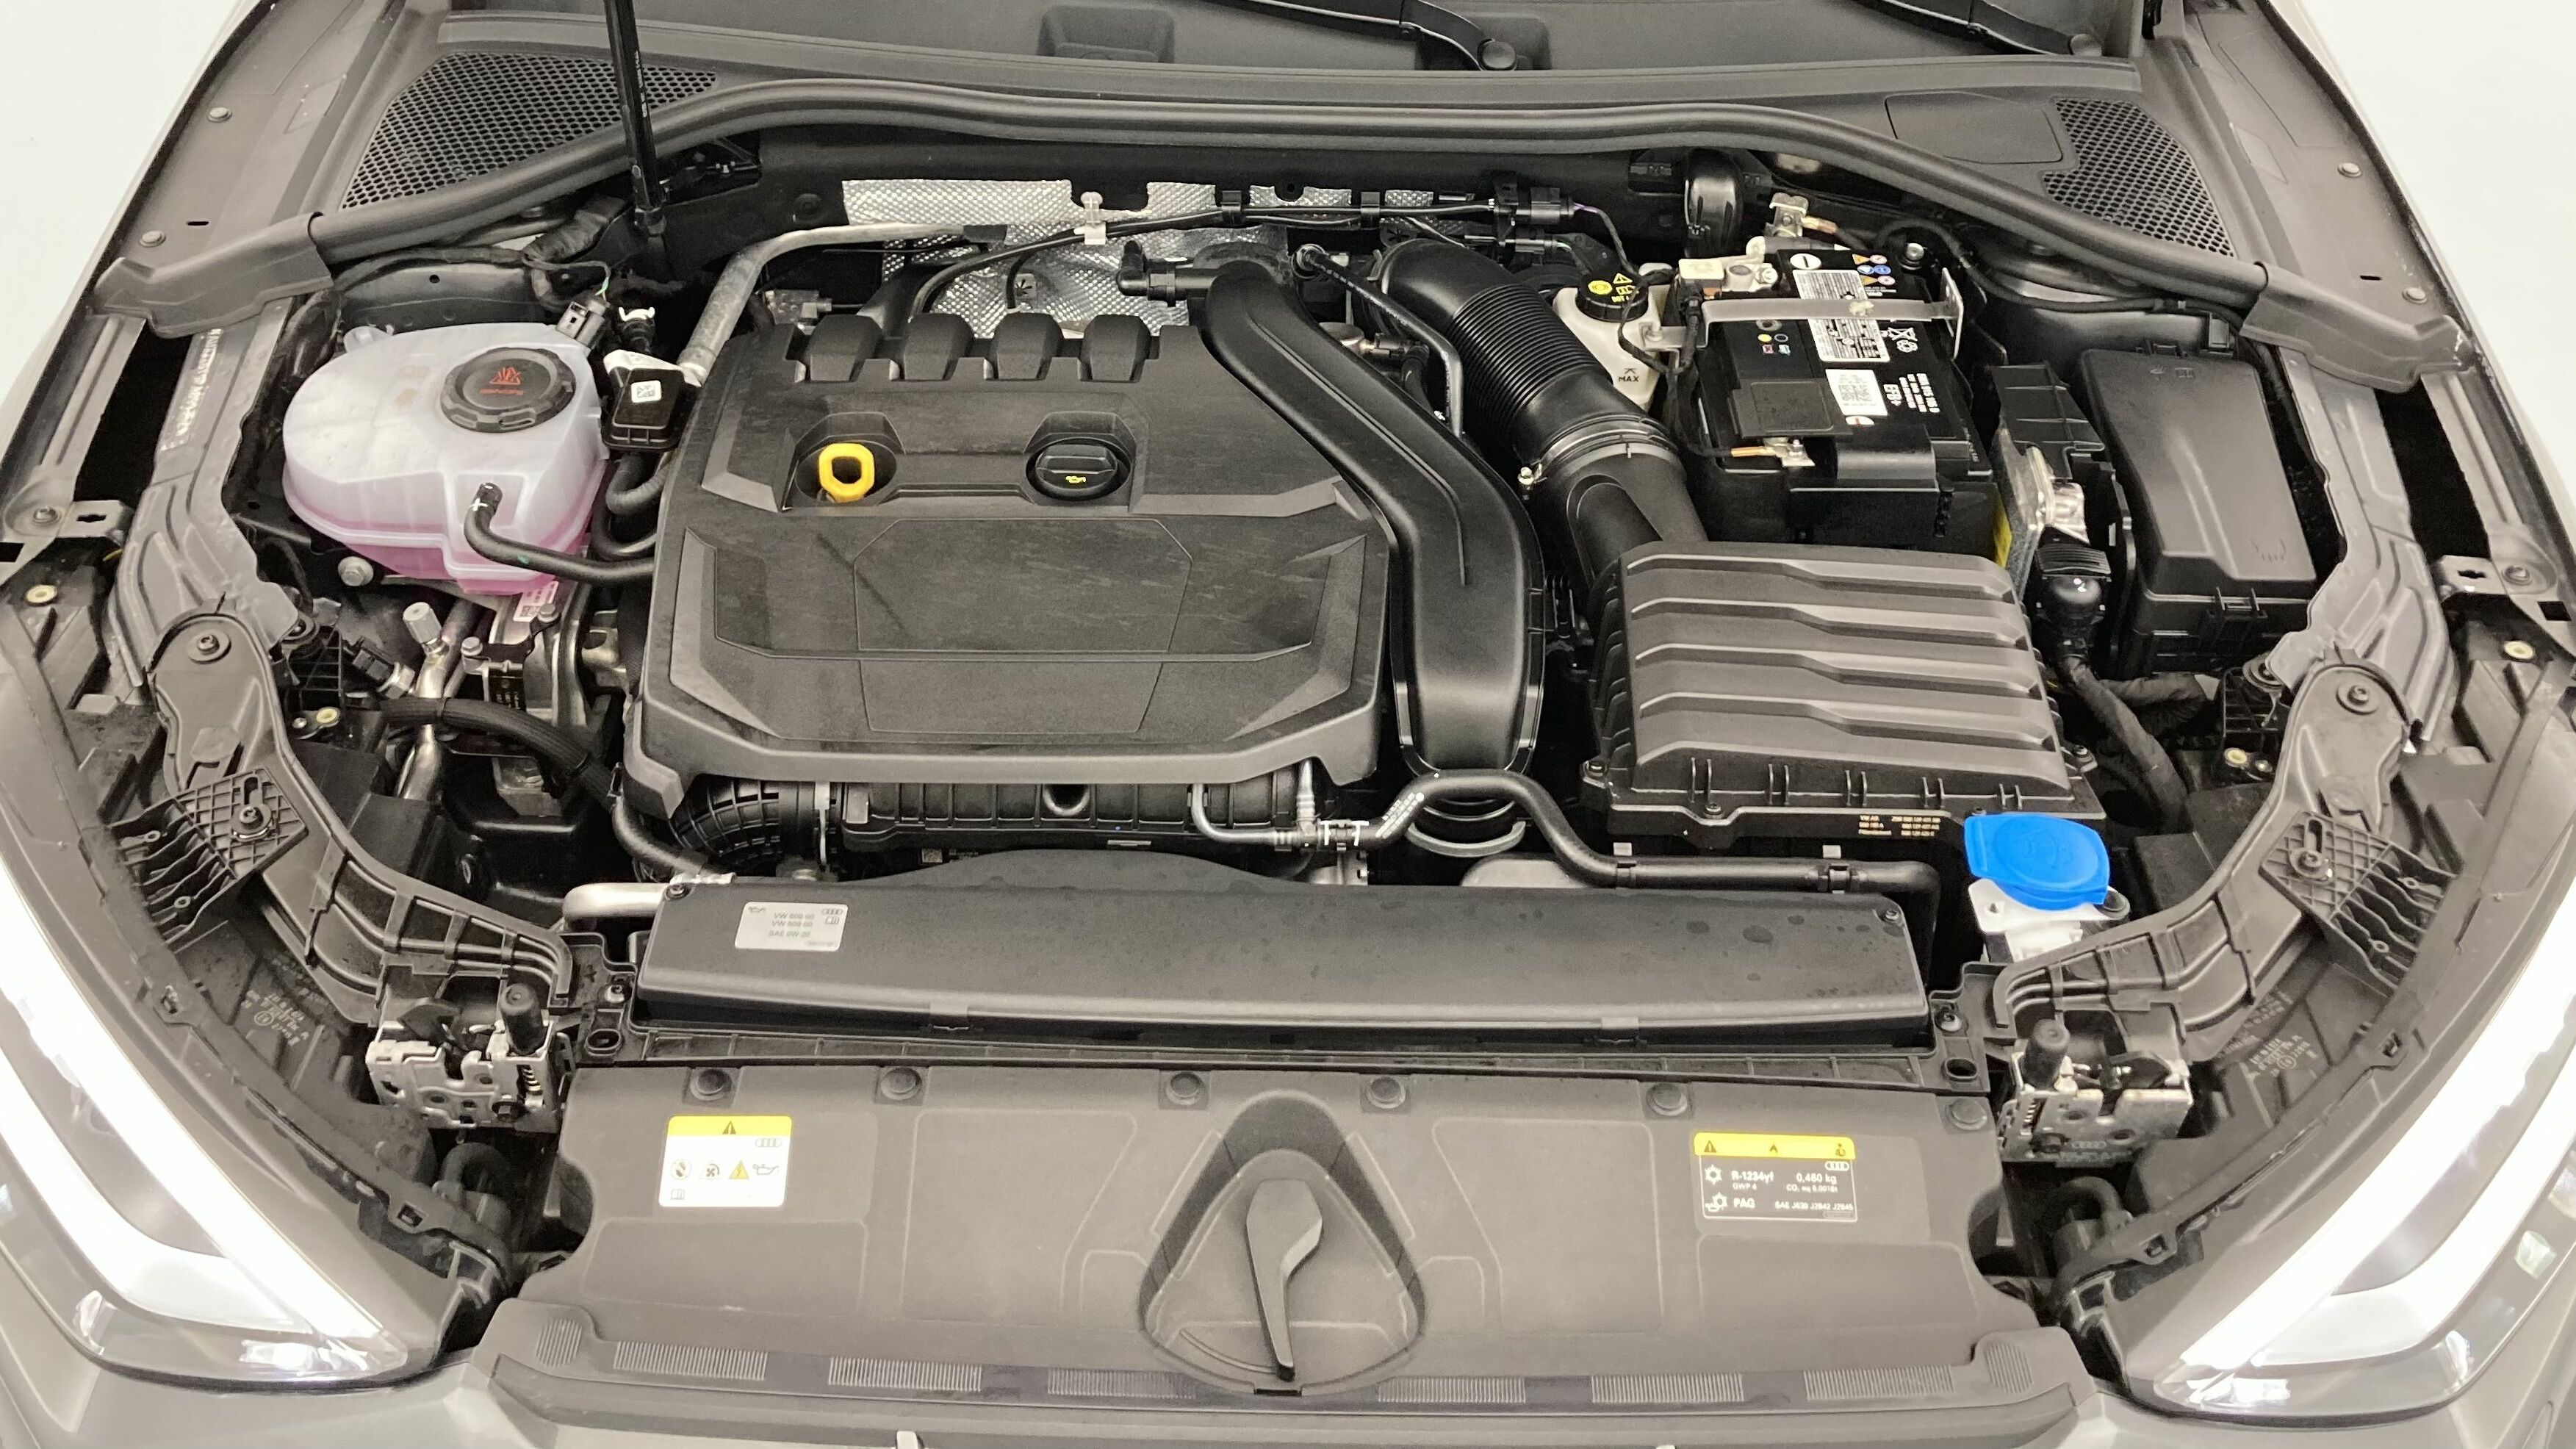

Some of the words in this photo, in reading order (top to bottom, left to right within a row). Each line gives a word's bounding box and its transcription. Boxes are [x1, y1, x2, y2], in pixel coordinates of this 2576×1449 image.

[1883, 384, 1903, 406] EFB+
[1731, 1171, 1774, 1184] R-1234yf
[1825, 1173, 1837, 1184] kg
[1733, 1198, 1755, 1209] PAG
[1774, 1200, 1790, 1209] SAE
